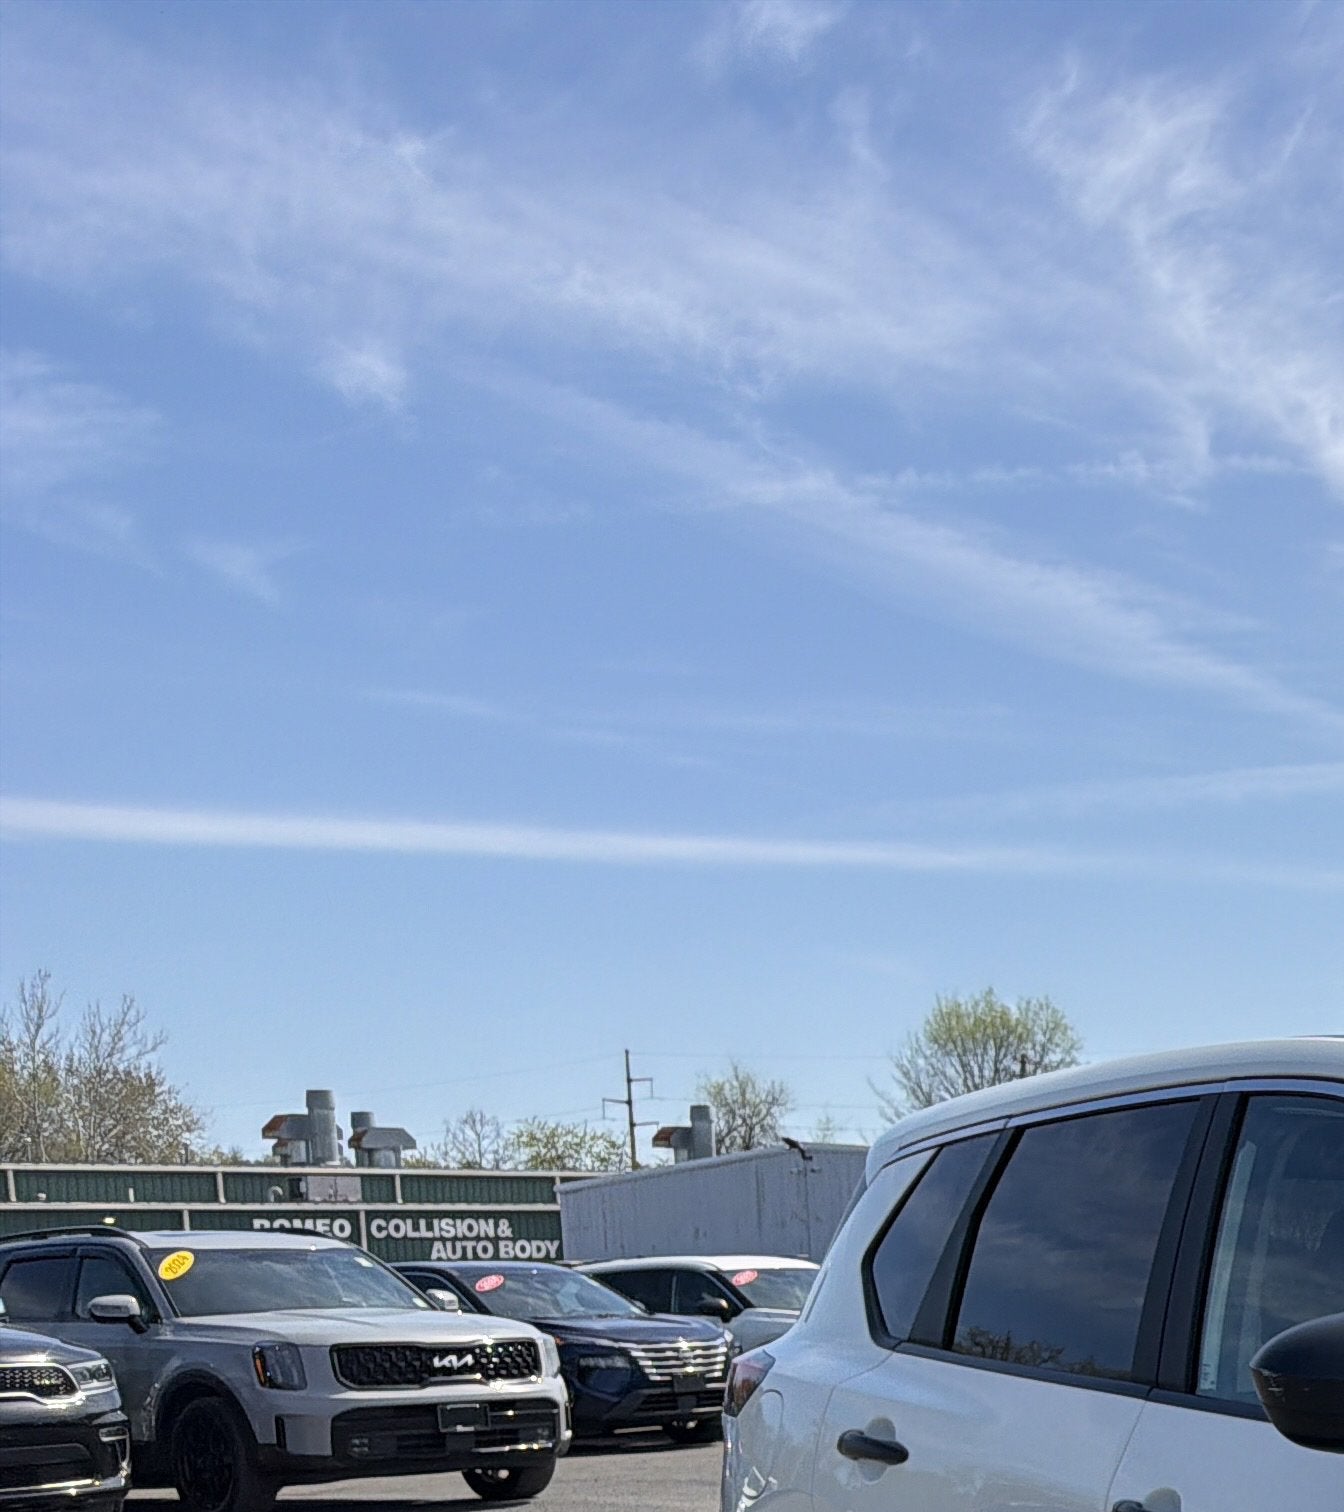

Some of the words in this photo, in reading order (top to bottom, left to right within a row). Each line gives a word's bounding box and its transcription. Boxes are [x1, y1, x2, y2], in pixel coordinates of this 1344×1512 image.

[370, 1218, 495, 1238] COLLISION
[497, 1218, 514, 1238] &
[430, 1240, 494, 1260] AUTO
[498, 1239, 561, 1259] BODY
